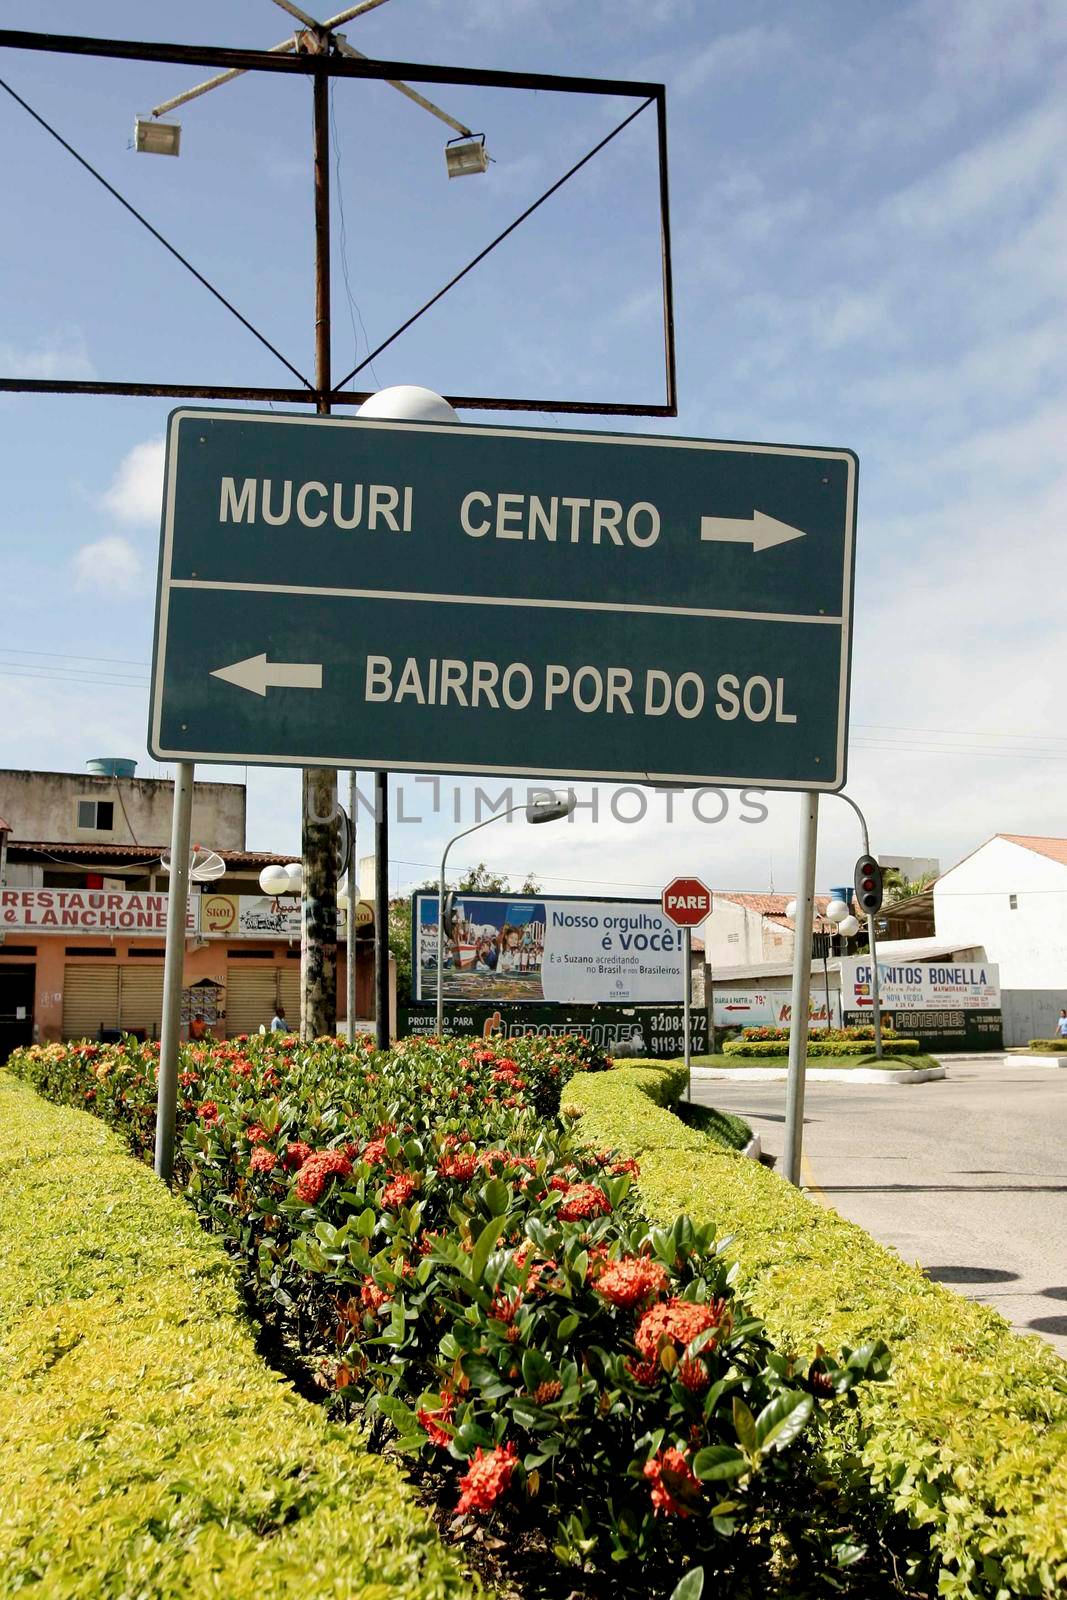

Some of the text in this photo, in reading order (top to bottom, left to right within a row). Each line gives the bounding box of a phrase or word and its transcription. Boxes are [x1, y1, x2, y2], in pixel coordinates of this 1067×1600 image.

[219, 476, 661, 548] MUCURI CENTRO
[365, 655, 797, 724] BAIRRO POR DO SOL
[667, 895, 707, 910] PARE
[206, 906, 231, 918] SKOL
[552, 911, 663, 933] Nosso orgulho
[601, 932, 613, 950] é
[564, 955, 594, 964] Suzano
[595, 954, 640, 965] acreditando
[586, 965, 597, 973] no
[598, 964, 622, 974] Brasil
[855, 966, 987, 985] GRNITOS BONELLA
[452, 1016, 474, 1026] PARA
[895, 1010, 966, 1028] PROTETORES
